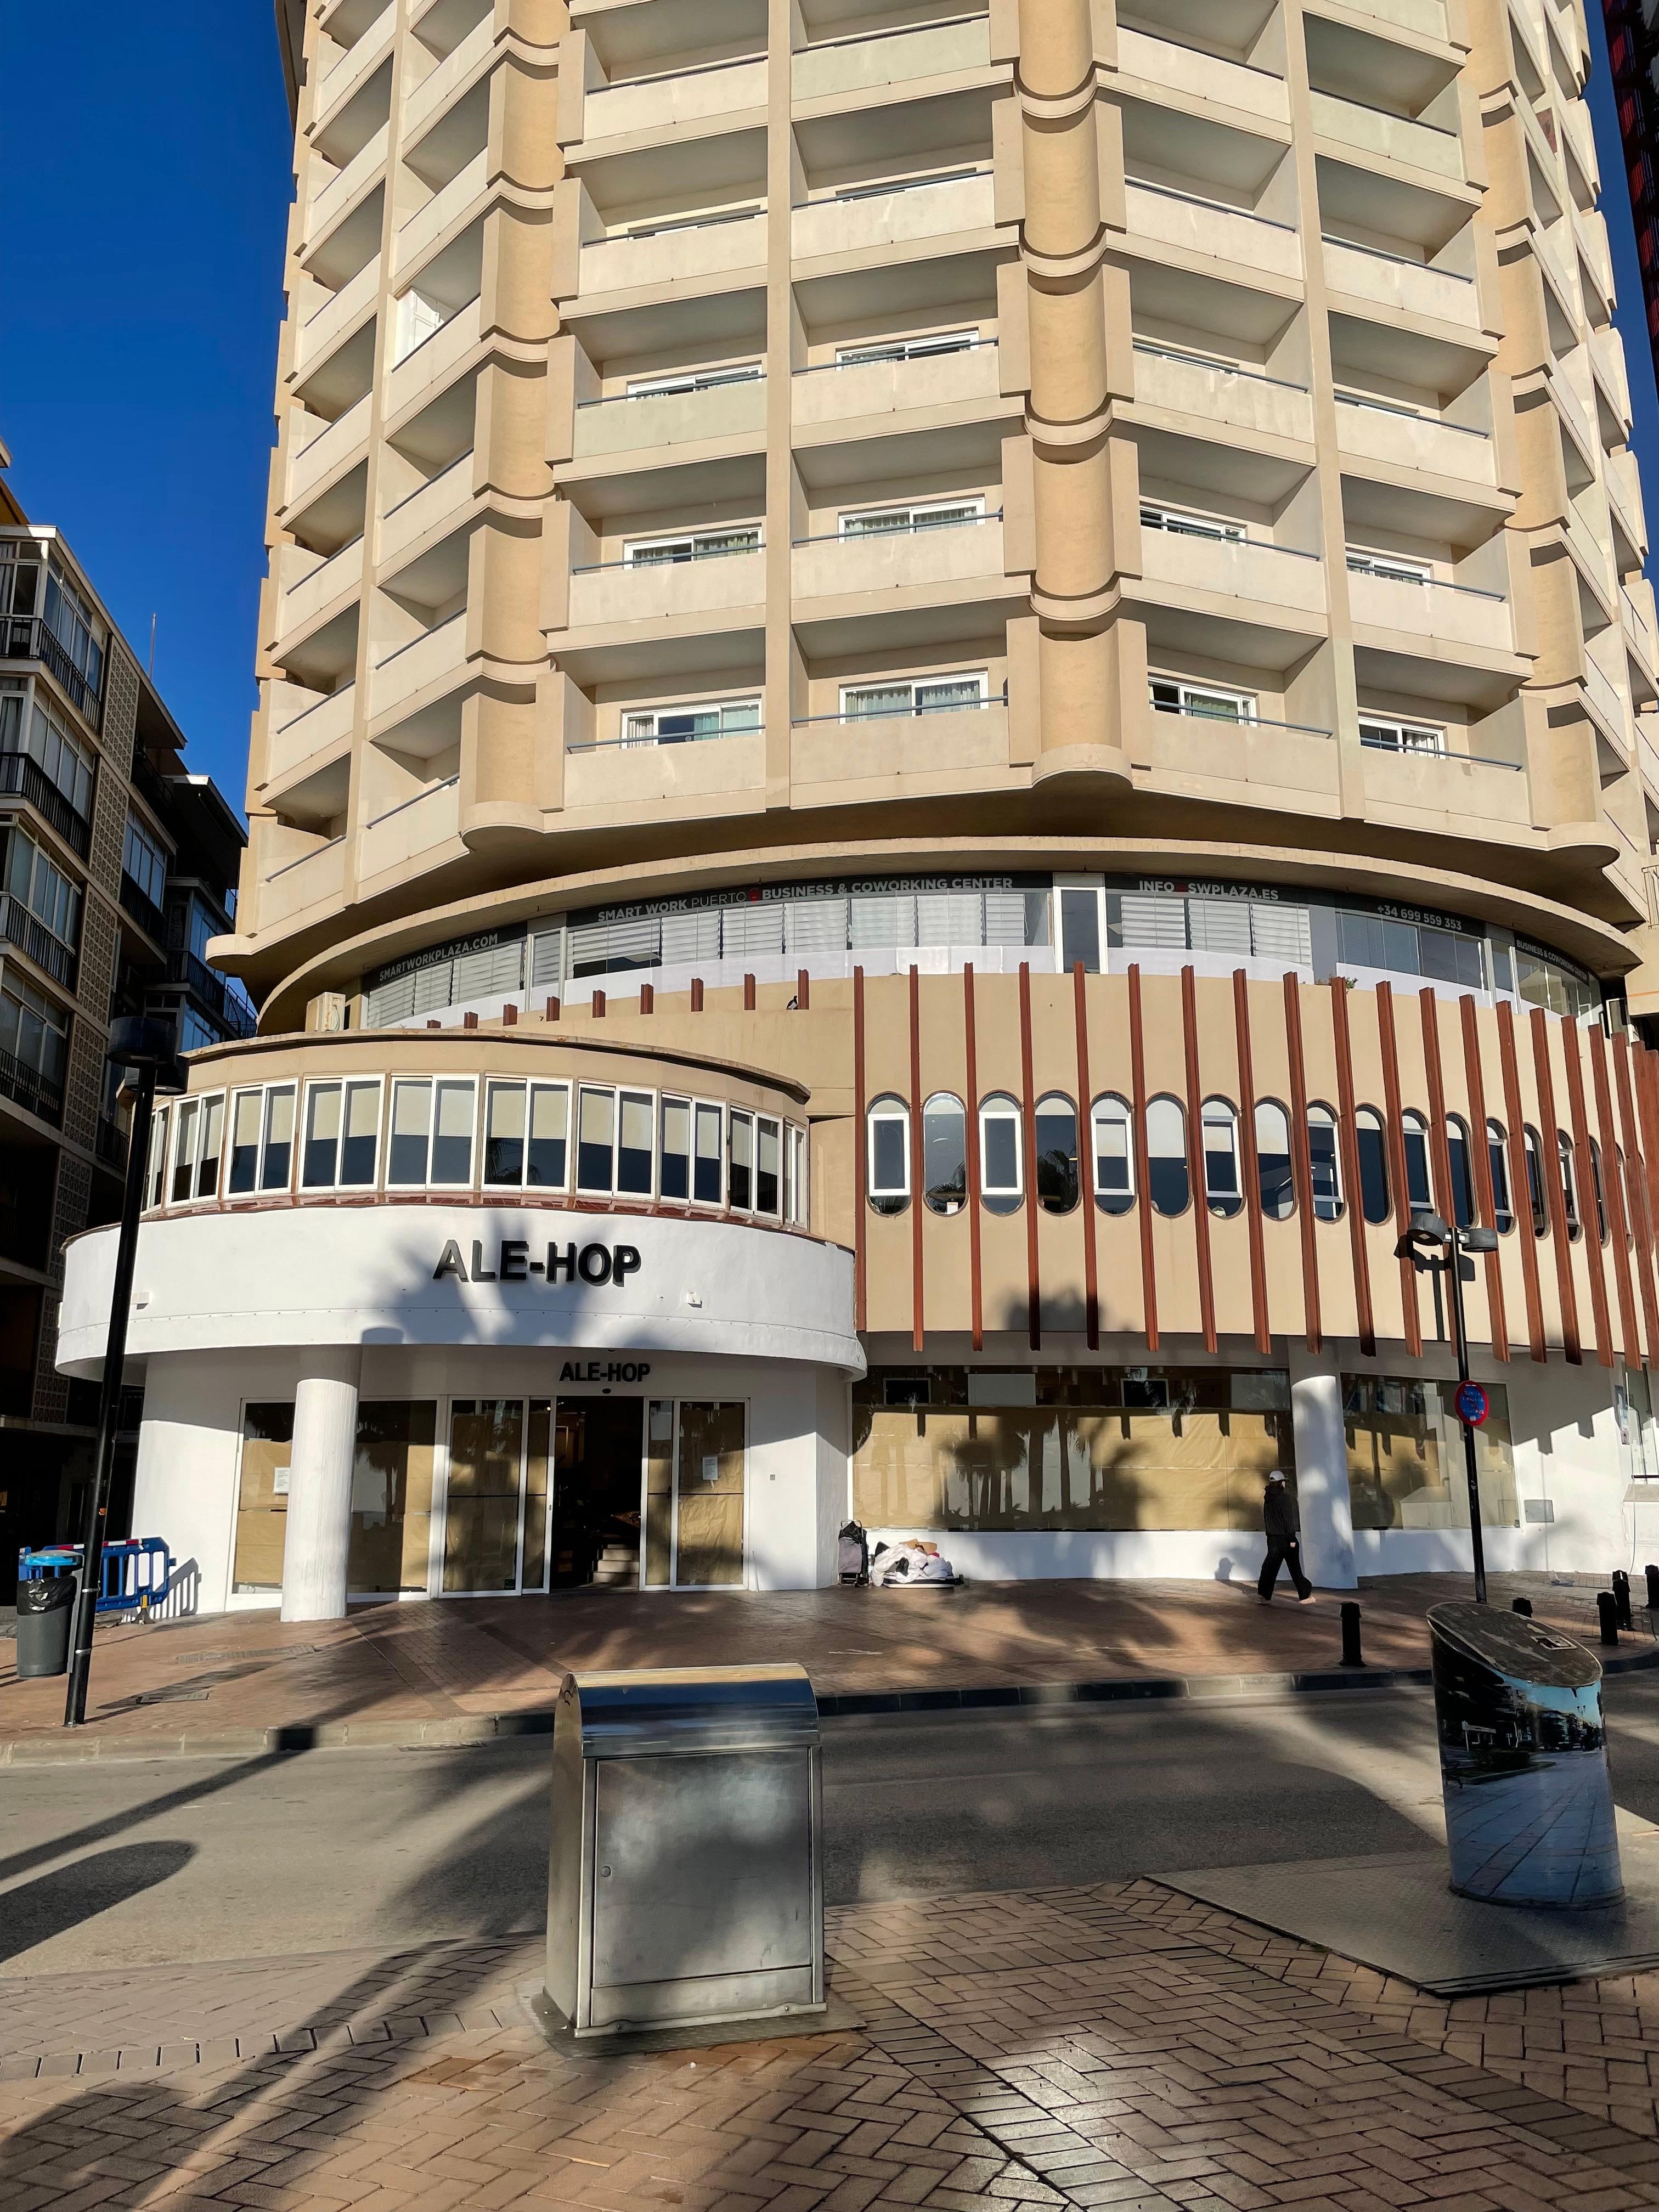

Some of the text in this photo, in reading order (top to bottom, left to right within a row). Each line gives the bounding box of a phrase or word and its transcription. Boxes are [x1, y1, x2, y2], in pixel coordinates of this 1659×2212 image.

[598, 878, 1013, 922] SMART WORK PUERTO BUSINESS & COWORKING CENTER
[1377, 905, 1462, 931] +34 699 559 353
[379, 933, 498, 981] SMARTWORKPLAZA.COM
[1516, 940, 1543, 956] BUSINESS
[433, 1239, 642, 1288] ALE-HOP
[559, 1362, 651, 1383] ALE-HOP
